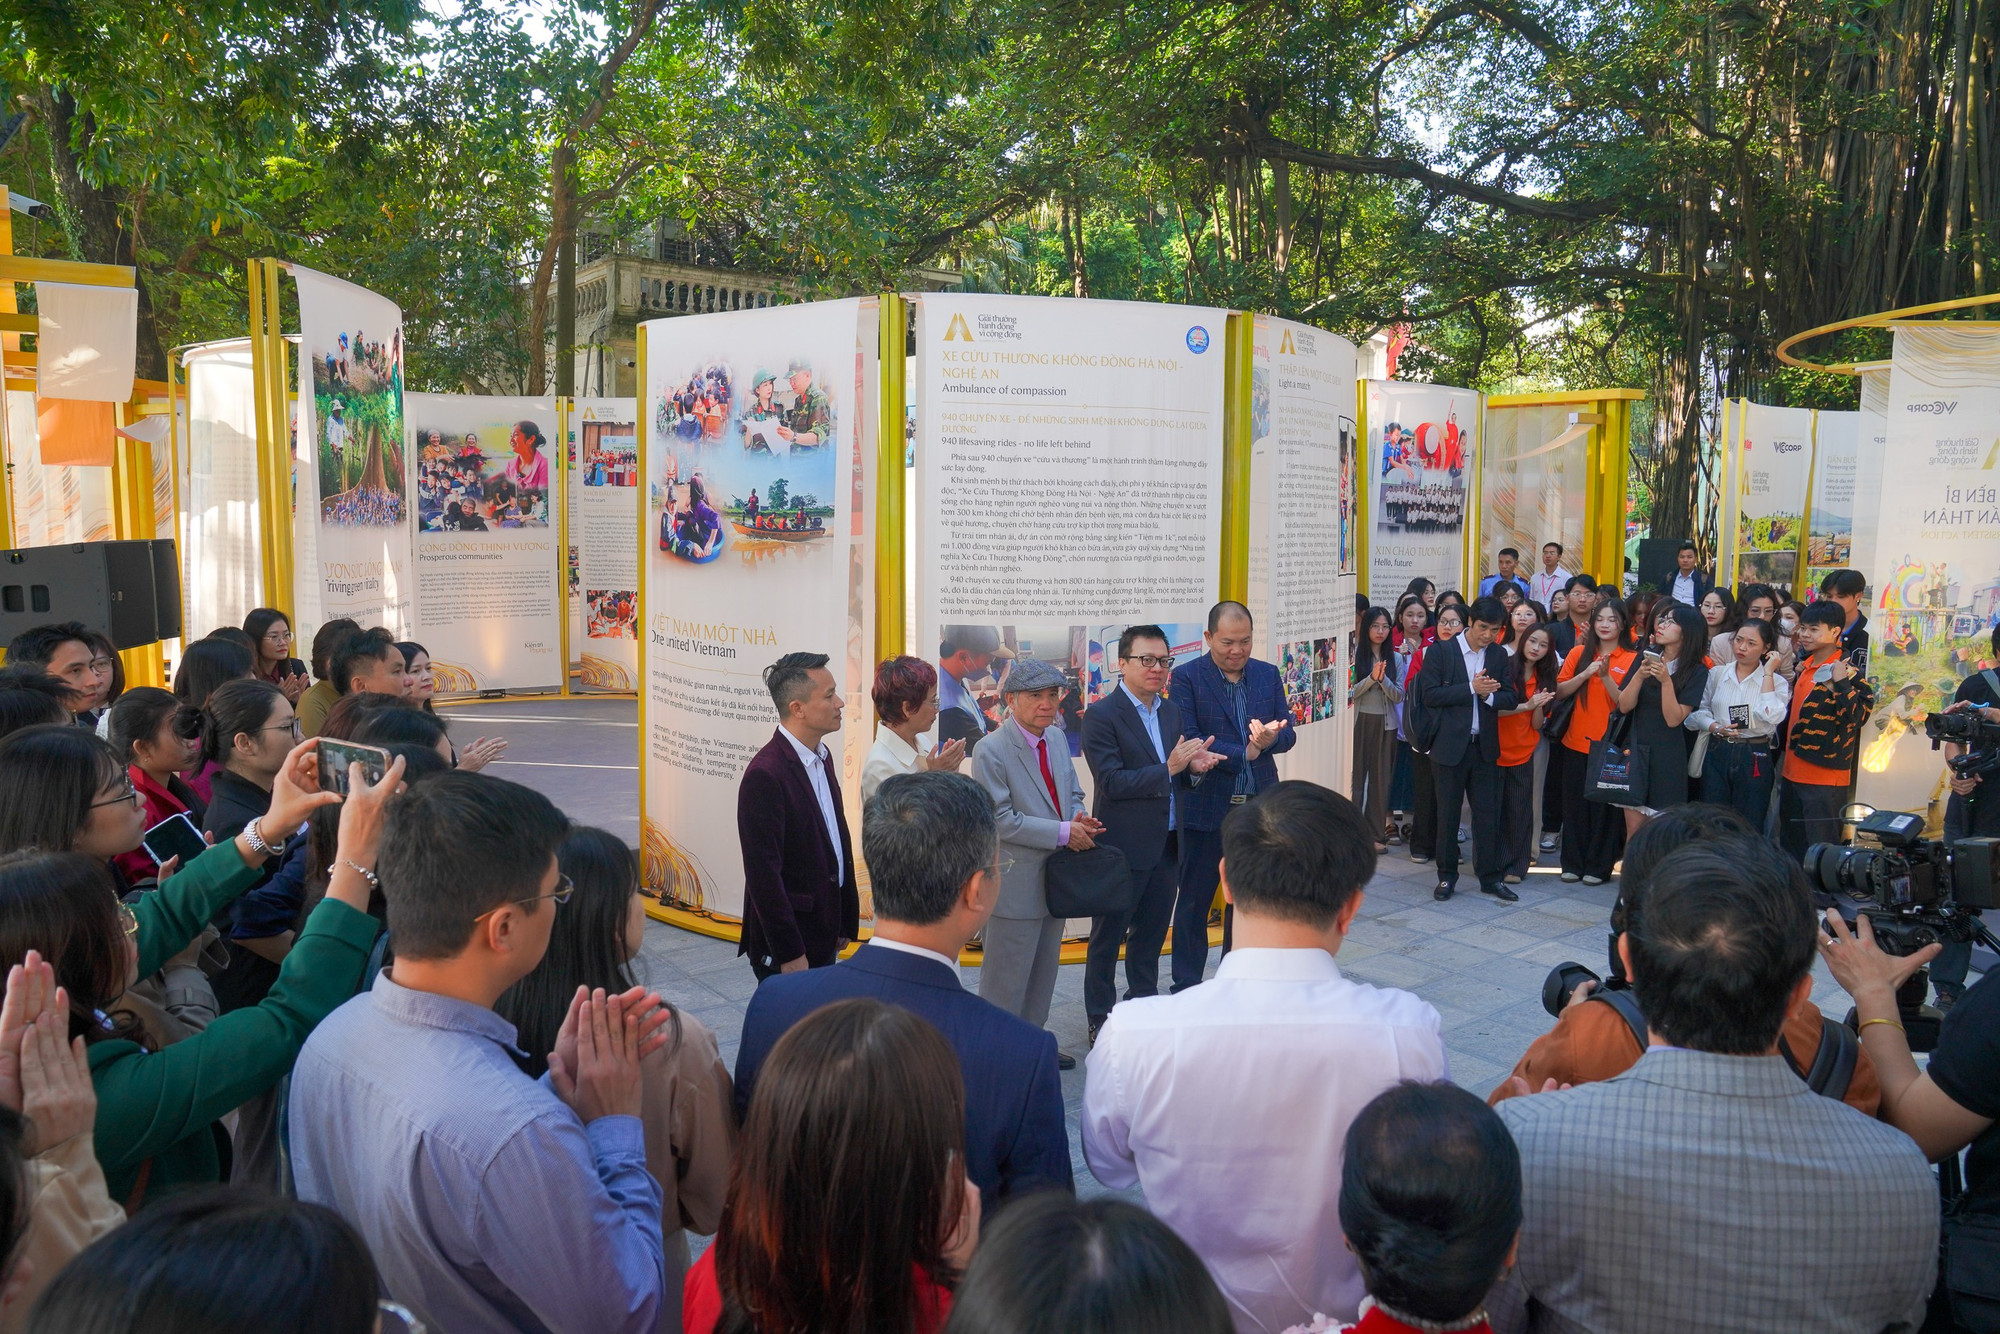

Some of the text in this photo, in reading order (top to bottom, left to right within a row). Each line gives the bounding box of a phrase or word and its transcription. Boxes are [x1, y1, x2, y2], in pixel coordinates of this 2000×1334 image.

[978, 314, 1016, 325] Giải thưởng
[979, 321, 1014, 333] hành động
[984, 329, 1004, 339] cộng
[1003, 328, 1021, 340] đồng
[943, 351, 957, 361] XE
[961, 350, 988, 362] CỨU
[994, 352, 1048, 364] THƯƠNG
[1053, 353, 1097, 366] KHÔNG
[1100, 355, 1135, 367] ĐỒNG
[1139, 356, 1154, 368] HÀ
[1158, 359, 1177, 372] NỘI
[943, 366, 999, 380] NGHỆ AN
[1279, 379, 1292, 389] Light
[942, 384, 1066, 397] Ambulance of compassion
[942, 413, 957, 421] 940
[959, 413, 996, 422] CHUYẾN
[1000, 415, 1010, 423] XE
[1033, 415, 1066, 424] NHỮNG
[1091, 416, 1116, 425] MỆNH
[1118, 417, 1149, 426] KHÔNG
[942, 424, 976, 433] ĐƯỜNG
[942, 437, 957, 445] 940
[959, 438, 995, 448] lifesaving
[998, 439, 1016, 447] rides
[1065, 440, 1090, 448] behind
[997, 455, 1021, 463] chuyến
[1179, 460, 1197, 468] nhưng
[955, 464, 965, 473] lay
[967, 465, 986, 473] động.
[992, 489, 1018, 497] Thương
[1021, 489, 1044, 497] Không
[1046, 490, 1065, 498] Đồng
[419, 542, 549, 554] CỘNG ĐỒNG THỊNH VƯỢNG
[1376, 546, 1391, 555] XIN
[1393, 547, 1416, 556] CHÀO
[420, 554, 457, 562] Prosperous
[1374, 558, 1412, 567] Hello, future
[673, 619, 700, 640] NAM
[705, 623, 739, 646] MỘT
[743, 626, 777, 645] NHÀ
[692, 639, 735, 658] Vietnam
[753, 689, 764, 697] Việt
[714, 739, 746, 752] Vietnamese
[705, 747, 724, 757] hearts
[707, 758, 736, 772] tempering
[692, 767, 735, 780] every adversity.
